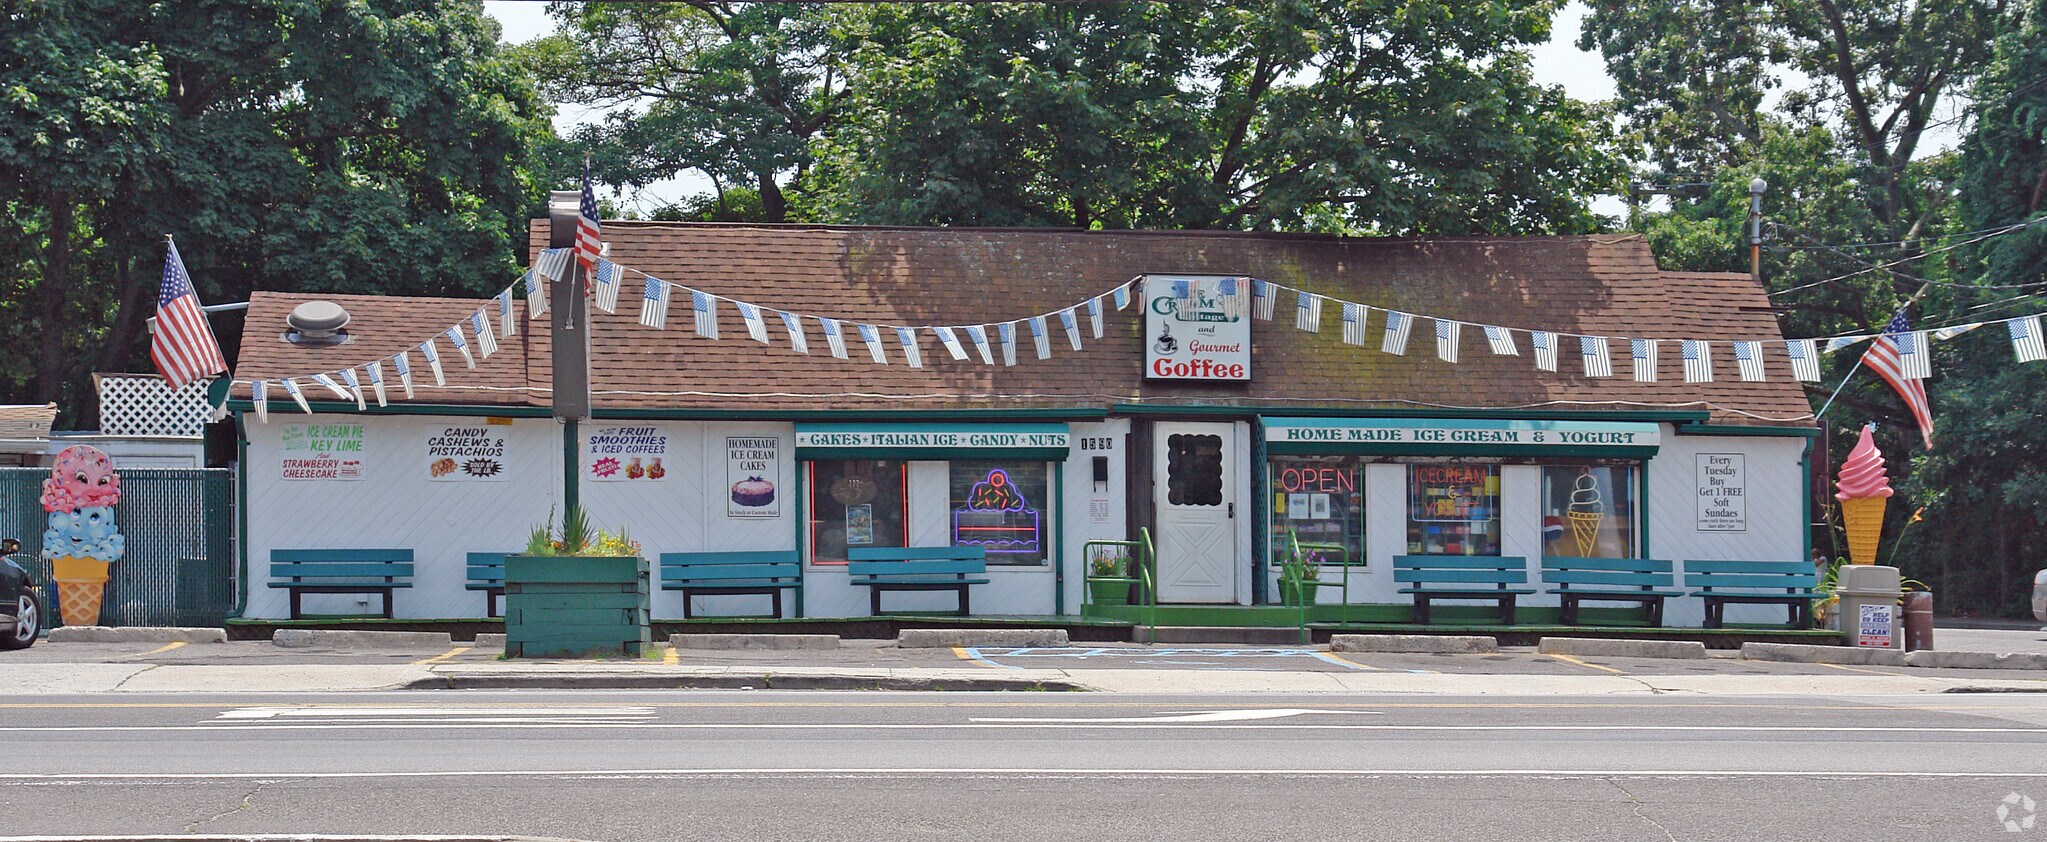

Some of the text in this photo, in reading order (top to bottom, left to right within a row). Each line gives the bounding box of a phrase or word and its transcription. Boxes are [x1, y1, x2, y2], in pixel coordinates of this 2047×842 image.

[1189, 340, 1240, 355] Gourmet
[1153, 358, 1244, 378] Coffee
[307, 425, 319, 437] ICE
[322, 425, 350, 438] CREAM
[352, 426, 364, 438] PIE
[444, 428, 488, 437] CANDY
[1287, 429, 1634, 444] HOME MADE ICE CREAM & YOGURT
[428, 437, 504, 447] CASHEWS &
[590, 436, 666, 444] SMOOTHIES
[729, 440, 776, 448] HOMEMADE
[810, 434, 1066, 446] CAKES ITALIAN ICE CANDY NUTS
[1081, 438, 1112, 450] 1590
[310, 440, 333, 451] KEY
[336, 440, 362, 451] LIME
[601, 445, 622, 453] ICED
[429, 447, 503, 456] PISTACHIOS
[731, 450, 774, 460] ICE CREAM
[282, 460, 339, 468] STRAWBERRY
[740, 461, 766, 470] CAKES
[1710, 456, 1732, 466] Every
[283, 470, 337, 478] CHEESECAKE
[1704, 466, 1737, 477] Tuesday
[1282, 468, 1354, 492] OPEN
[1710, 477, 1725, 487] Buy
[1699, 487, 1743, 496] Get 1 FREE
[1714, 498, 1729, 507] Soft
[1705, 508, 1738, 517] Sundaes
